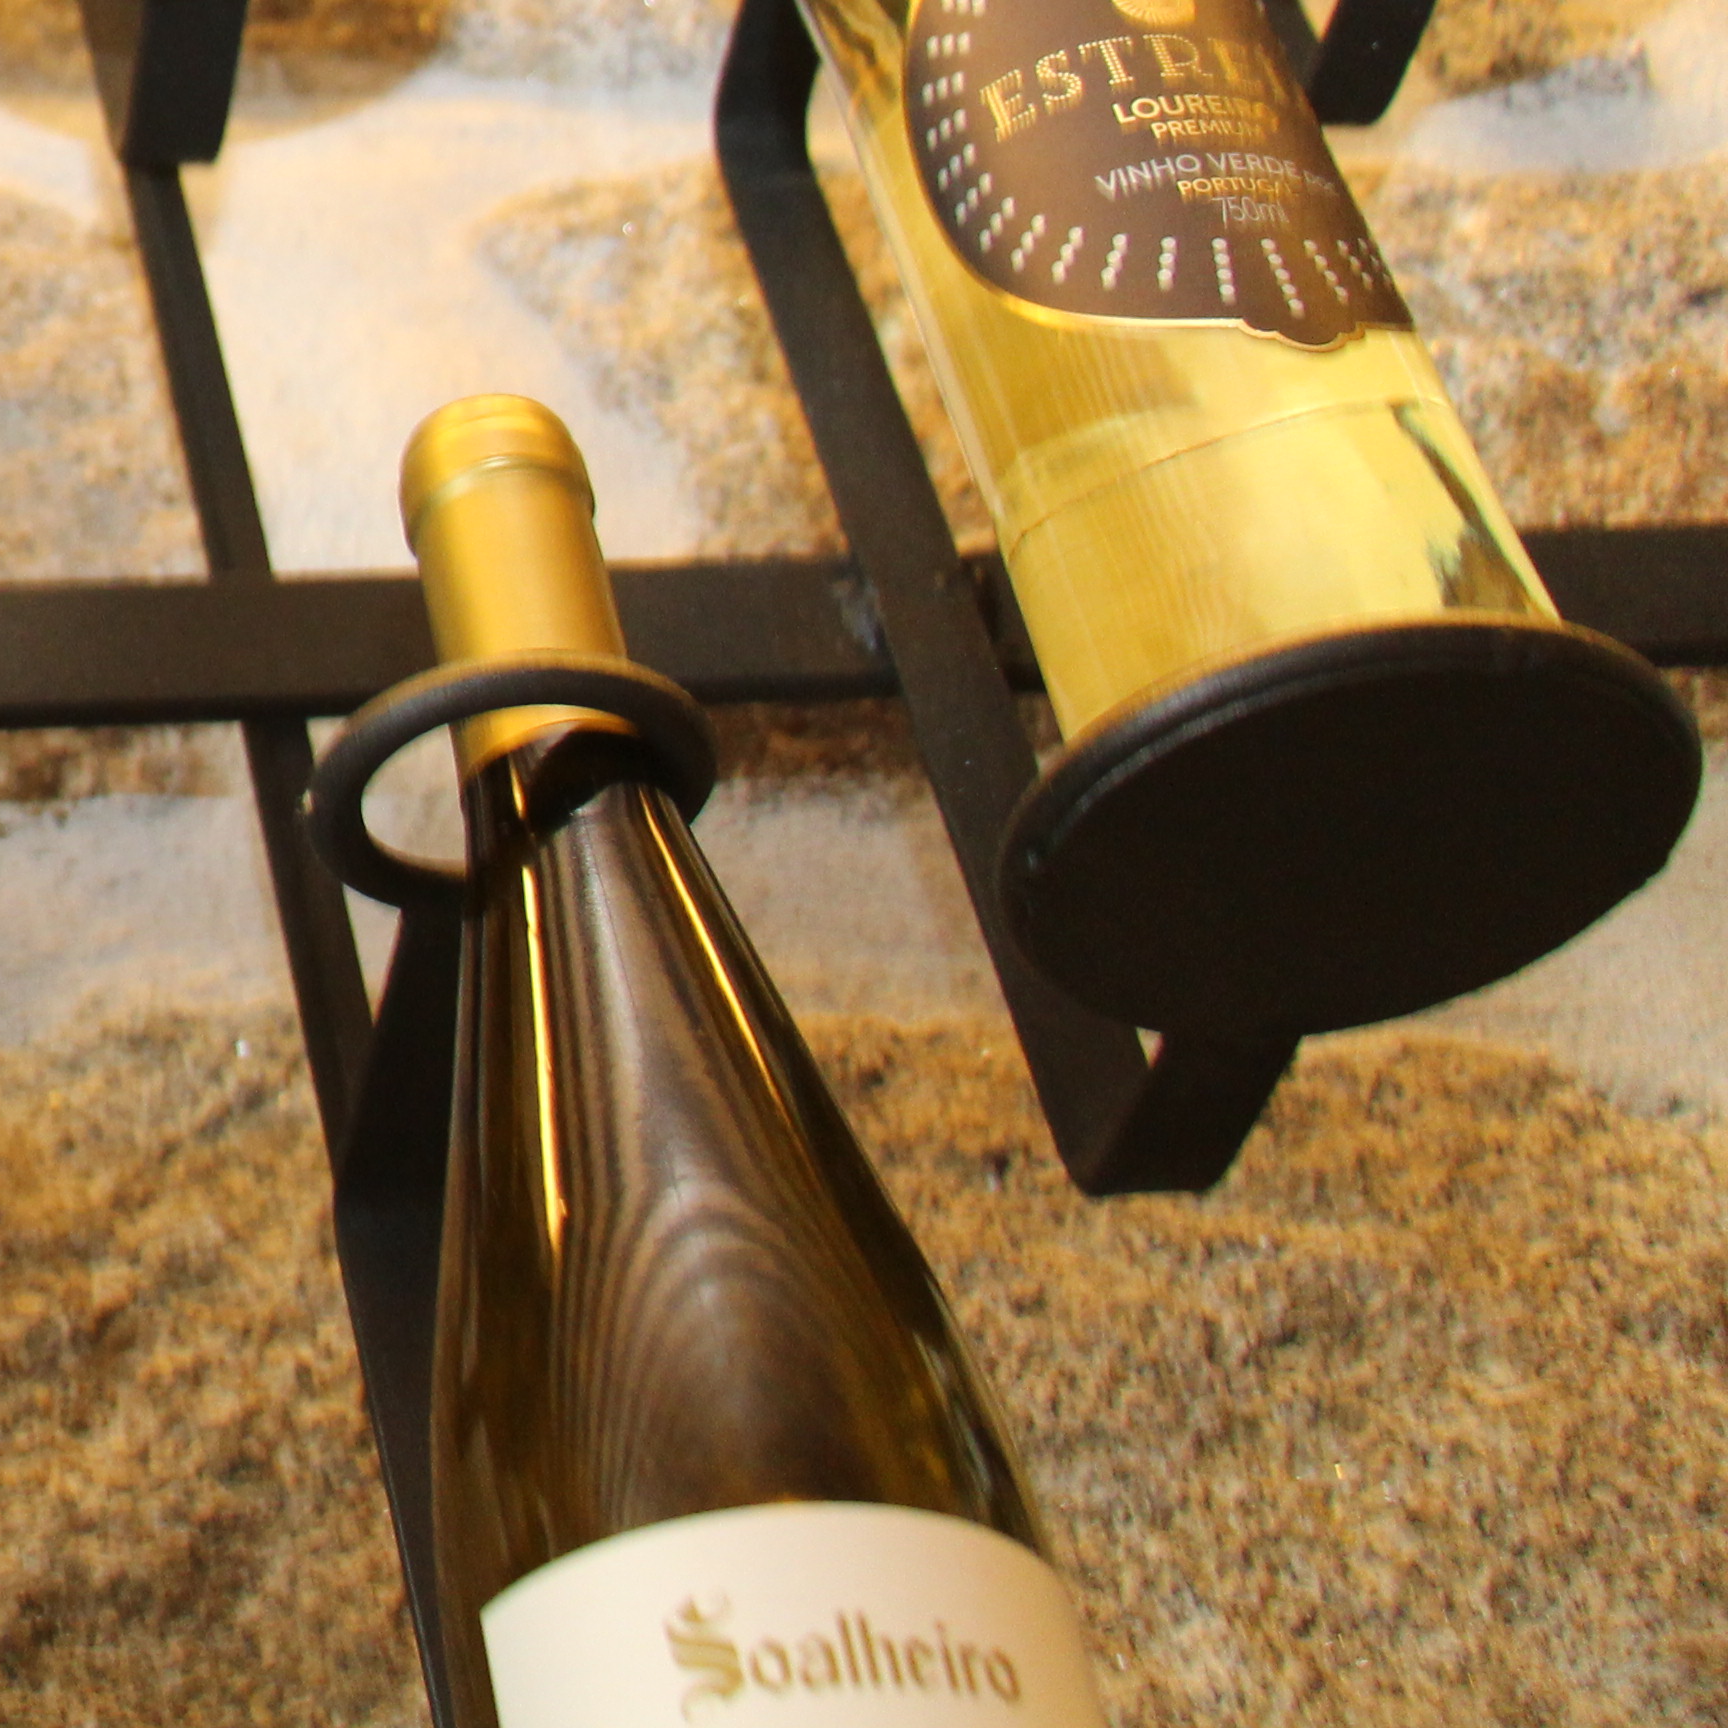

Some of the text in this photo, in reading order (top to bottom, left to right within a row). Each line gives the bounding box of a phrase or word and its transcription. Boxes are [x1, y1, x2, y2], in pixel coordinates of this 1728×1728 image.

[1111, 90, 1280, 136] LOUREIRO
[1094, 151, 1202, 202] VINHO
[1205, 150, 1297, 181] VERDE
[1211, 194, 1292, 228] 750ml
[662, 1592, 1021, 1724] Soalheiro
